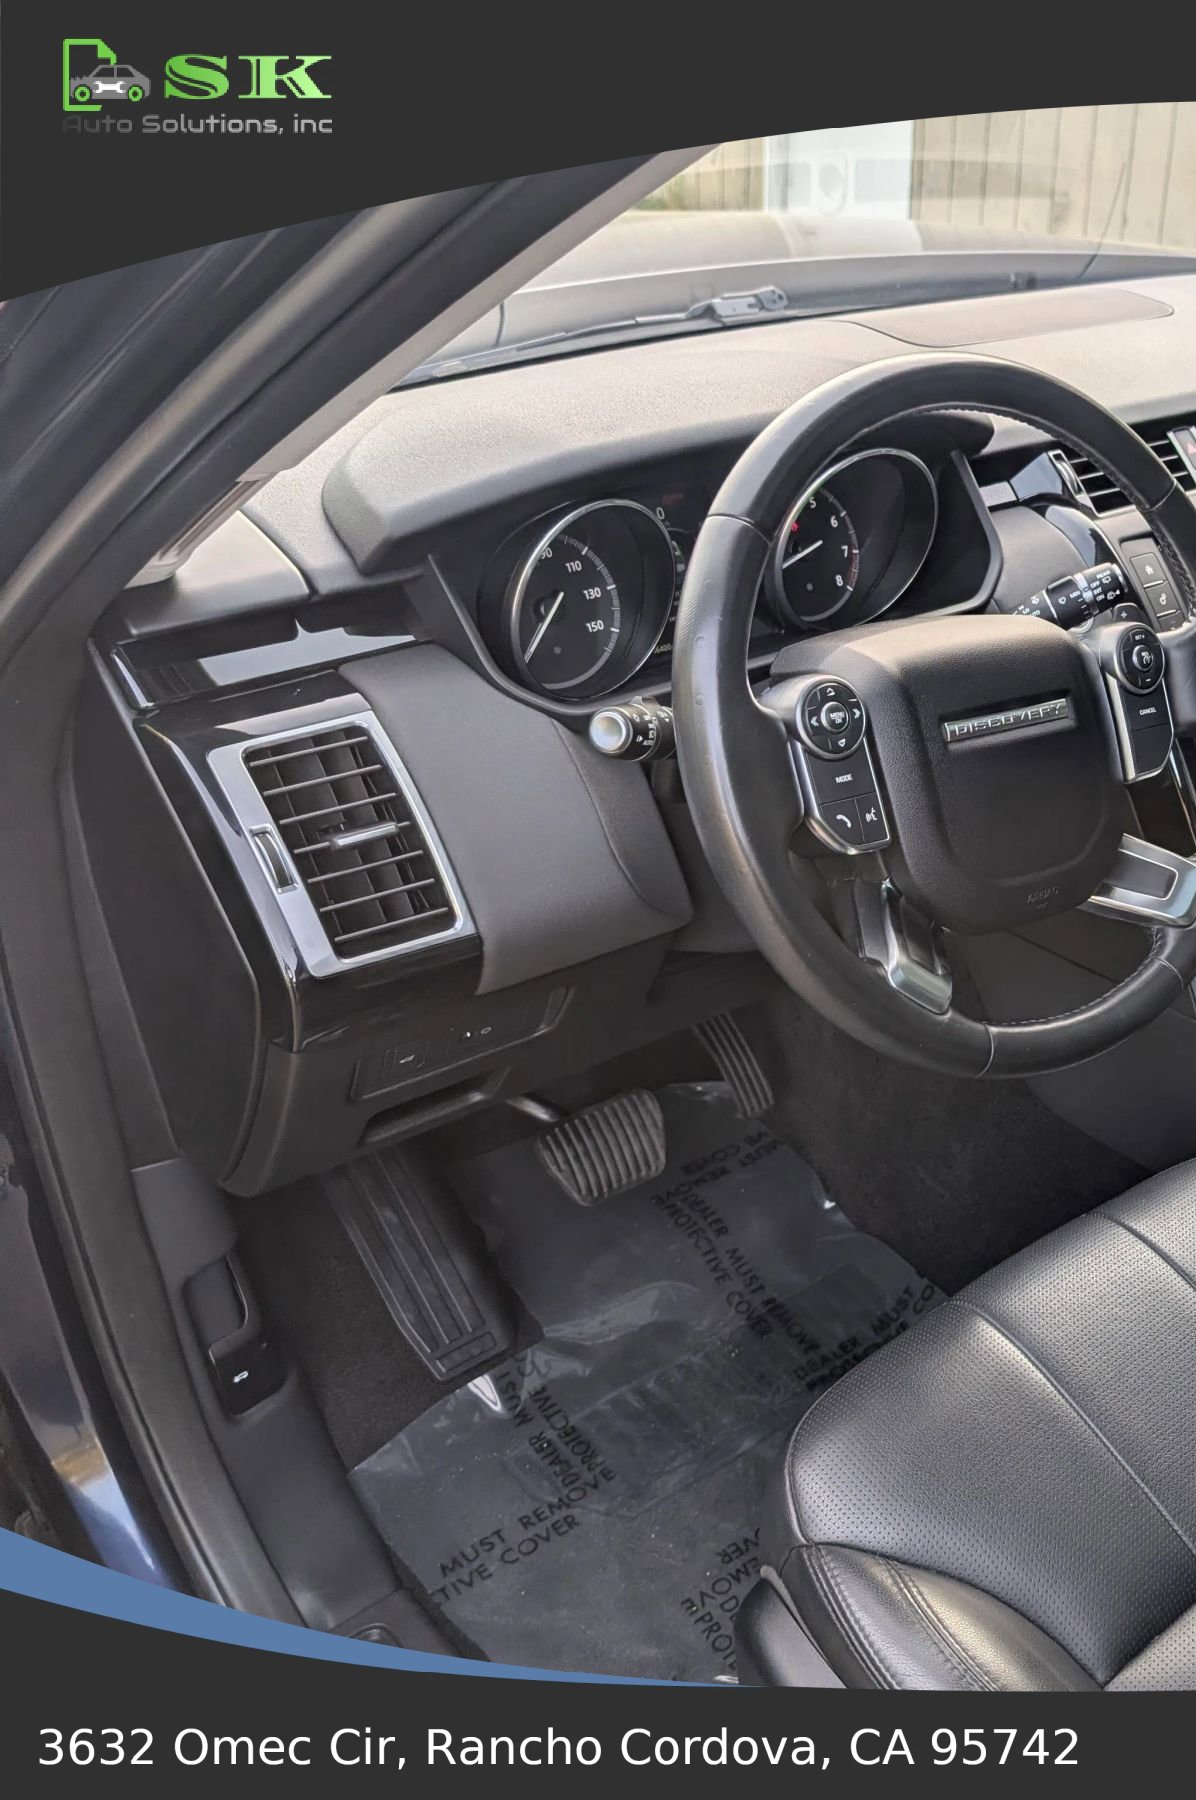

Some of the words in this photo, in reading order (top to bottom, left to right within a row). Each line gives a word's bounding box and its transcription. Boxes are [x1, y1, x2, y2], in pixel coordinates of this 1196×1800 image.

[809, 497, 817, 509] 5
[830, 515, 839, 528] 6
[841, 545, 849, 558] 7
[565, 561, 583, 574] 110
[835, 574, 844, 587] 8
[583, 587, 602, 600] 130
[586, 620, 605, 633] 150
[1139, 706, 1157, 716] CANCEL
[954, 702, 1064, 737] DISCOVERY
[835, 774, 853, 784] MODE
[439, 1527, 507, 1579] MUST
[518, 1468, 618, 1532] REMOVE
[501, 1512, 581, 1566] COVER
